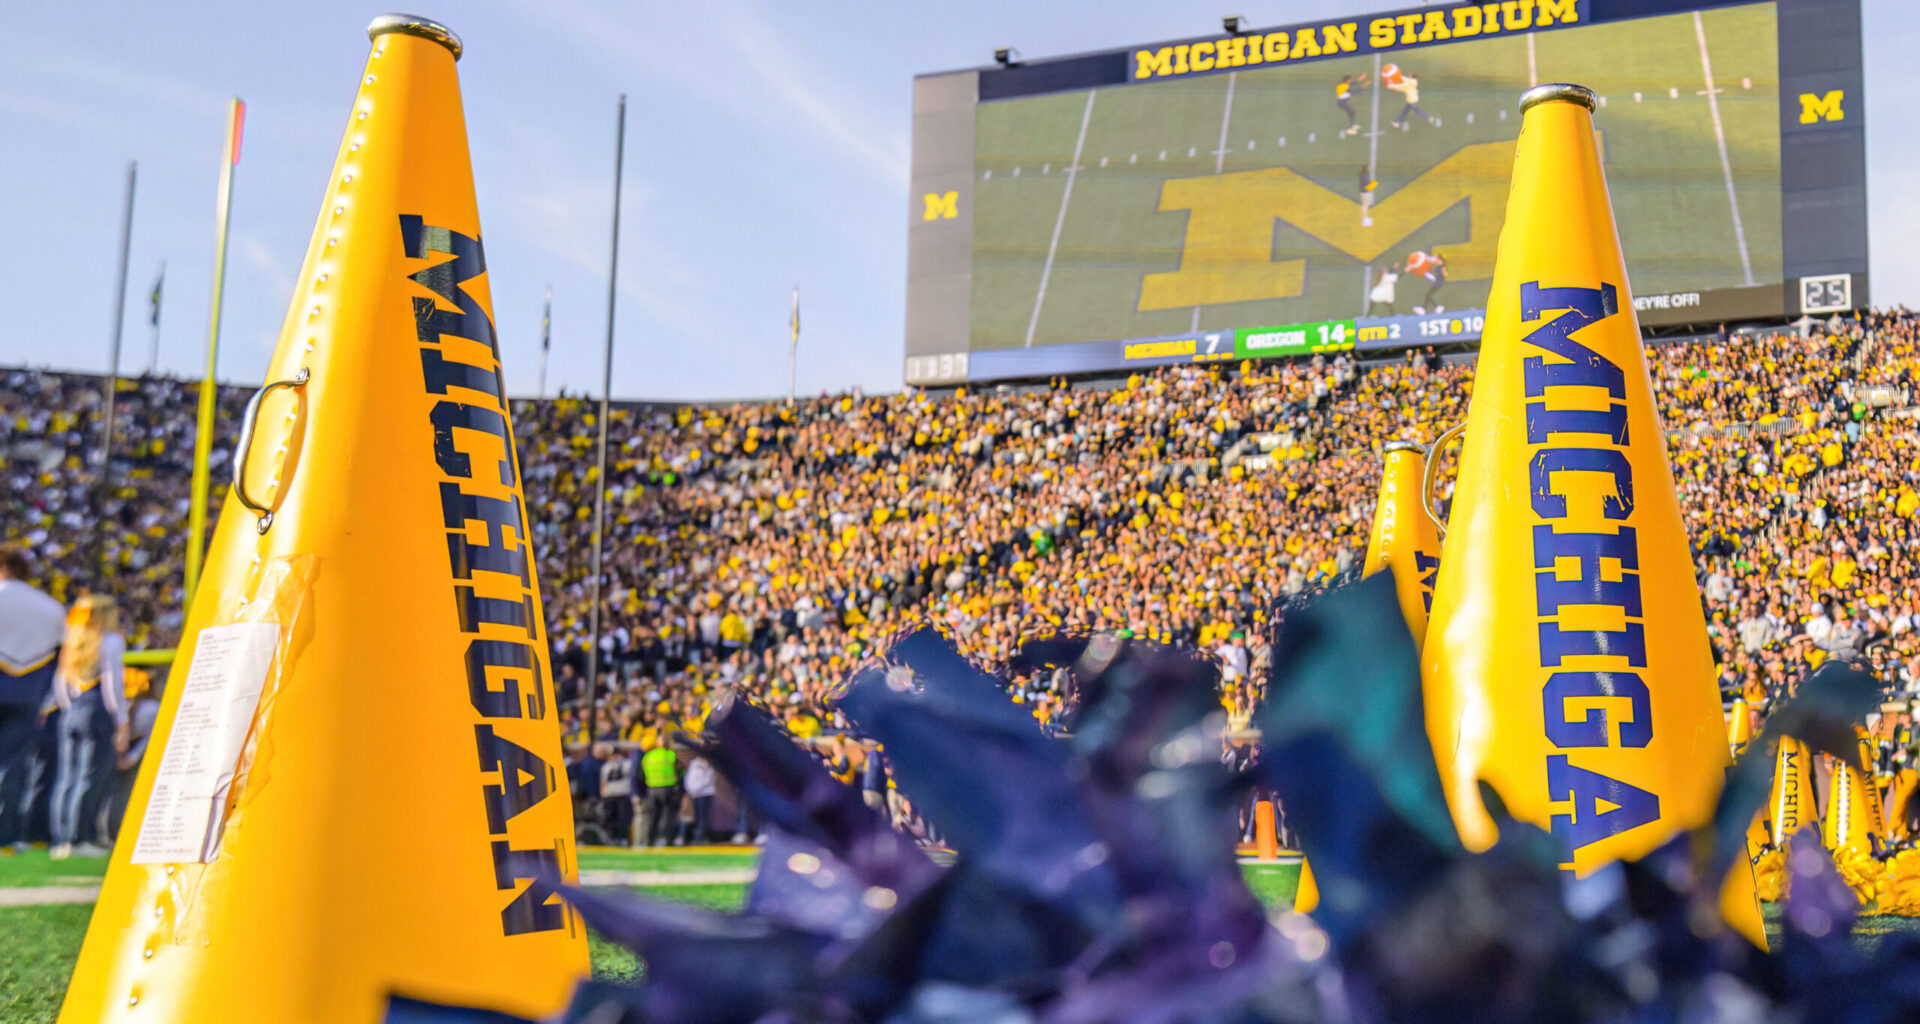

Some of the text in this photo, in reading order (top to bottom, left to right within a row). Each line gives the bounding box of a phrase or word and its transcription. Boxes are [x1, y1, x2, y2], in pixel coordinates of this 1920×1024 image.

[1135, 0, 1578, 79] MICHIGAN STADIUM
[1799, 89, 1844, 124] M
[923, 190, 959, 221] M
[1633, 295, 1670, 311] HEY'RE
[1807, 281, 1845, 307] 25
[1317, 323, 1346, 345] 14
[1389, 323, 1401, 339] 2
[1419, 319, 1449, 337] 1ST
[1463, 316, 1484, 333] 10
[1204, 333, 1221, 354] 7
[398, 214, 577, 939] MICHIGAN
[1520, 280, 1661, 864] MICHIGA
[1781, 751, 1798, 835] MICHIG
